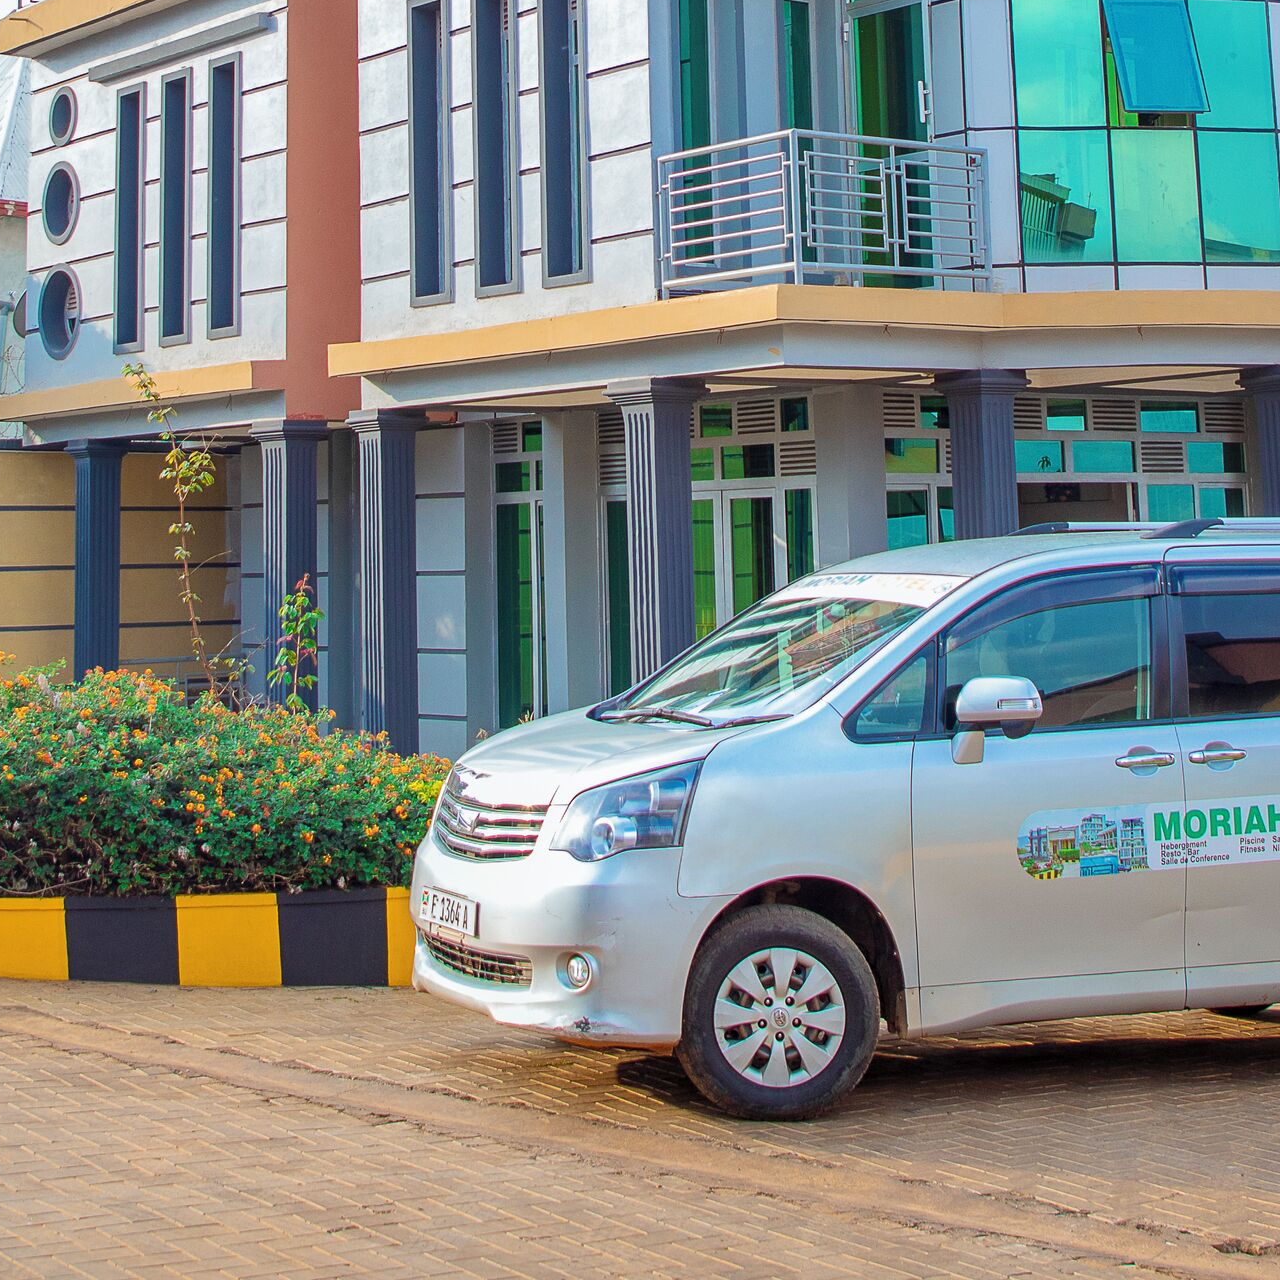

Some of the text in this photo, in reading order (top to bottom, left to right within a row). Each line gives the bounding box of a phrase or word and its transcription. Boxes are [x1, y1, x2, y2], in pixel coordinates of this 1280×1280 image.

[1160, 840, 1207, 850] Hebergement
[1239, 837, 1265, 845] Piscine
[1160, 849, 1181, 858] Resto
[1187, 848, 1199, 856] Bar
[1239, 845, 1265, 854] Fitness
[1160, 857, 1178, 865] Salle
[1190, 853, 1230, 863] Conference
[439, 896, 461, 927] 1364
[462, 905, 468, 930] A
